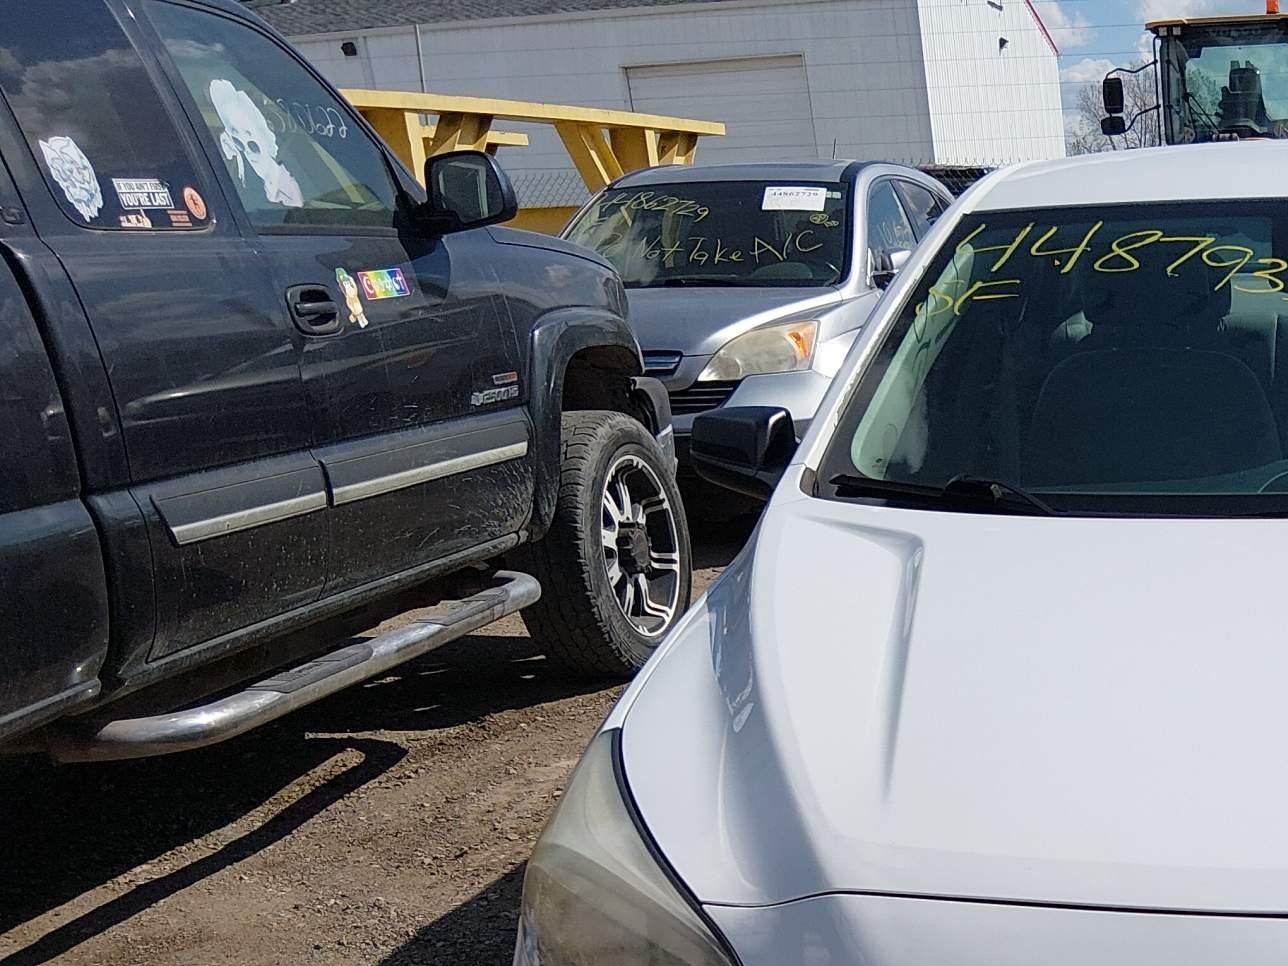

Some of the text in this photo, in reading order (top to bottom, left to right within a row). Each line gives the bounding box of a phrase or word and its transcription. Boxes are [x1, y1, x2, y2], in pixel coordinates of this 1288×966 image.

[120, 192, 171, 206] YOU'RE LAST
[639, 236, 685, 262] Not
[688, 236, 745, 265] Take
[750, 229, 823, 264] A/C
